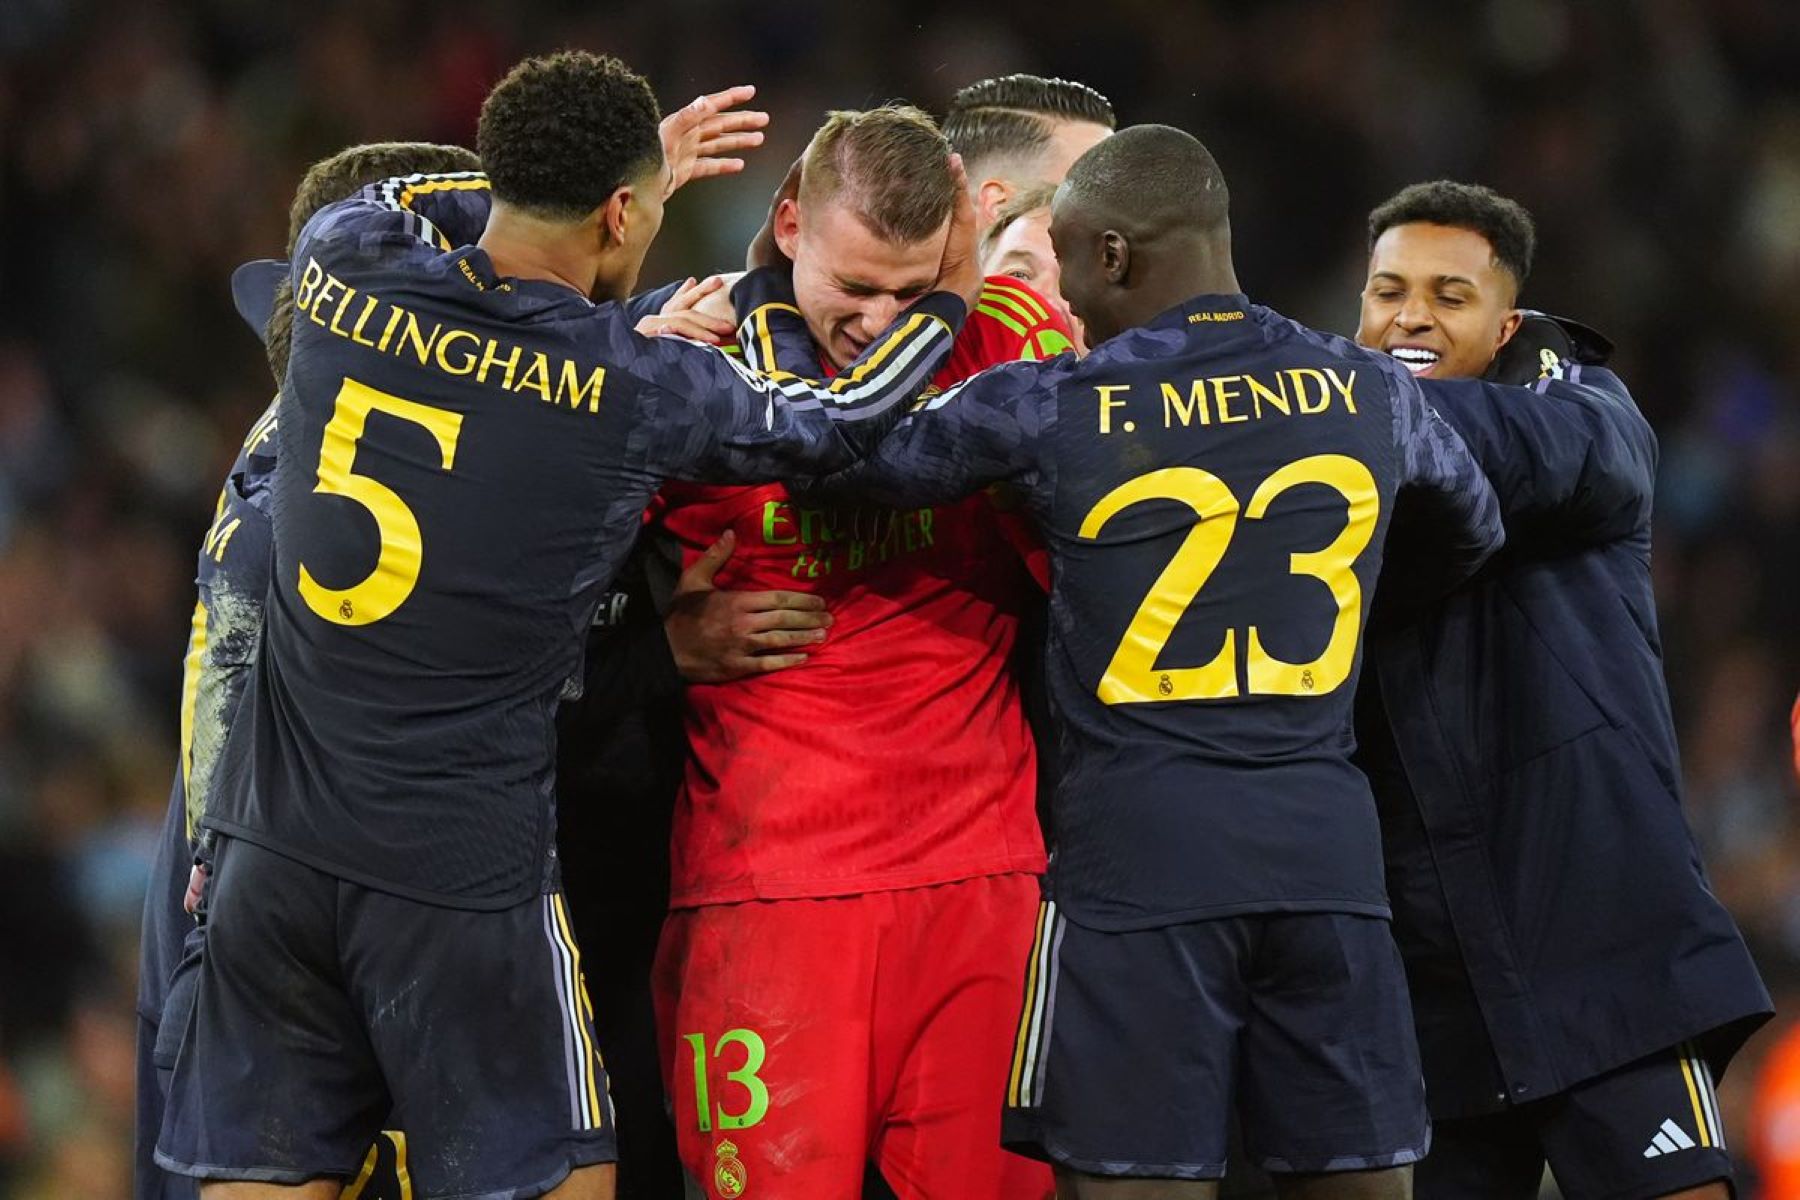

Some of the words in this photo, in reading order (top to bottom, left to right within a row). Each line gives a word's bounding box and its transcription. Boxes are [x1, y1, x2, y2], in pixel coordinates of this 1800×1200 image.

[297, 256, 606, 413] BELLINGHAM
[1187, 312, 1213, 324] REAL
[1213, 310, 1245, 322] MADRID
[1093, 384, 1136, 434] F.
[1161, 367, 1357, 429] MENDY
[297, 376, 464, 626] 5
[1077, 453, 1381, 706] 23
[683, 1028, 769, 1132] 13
